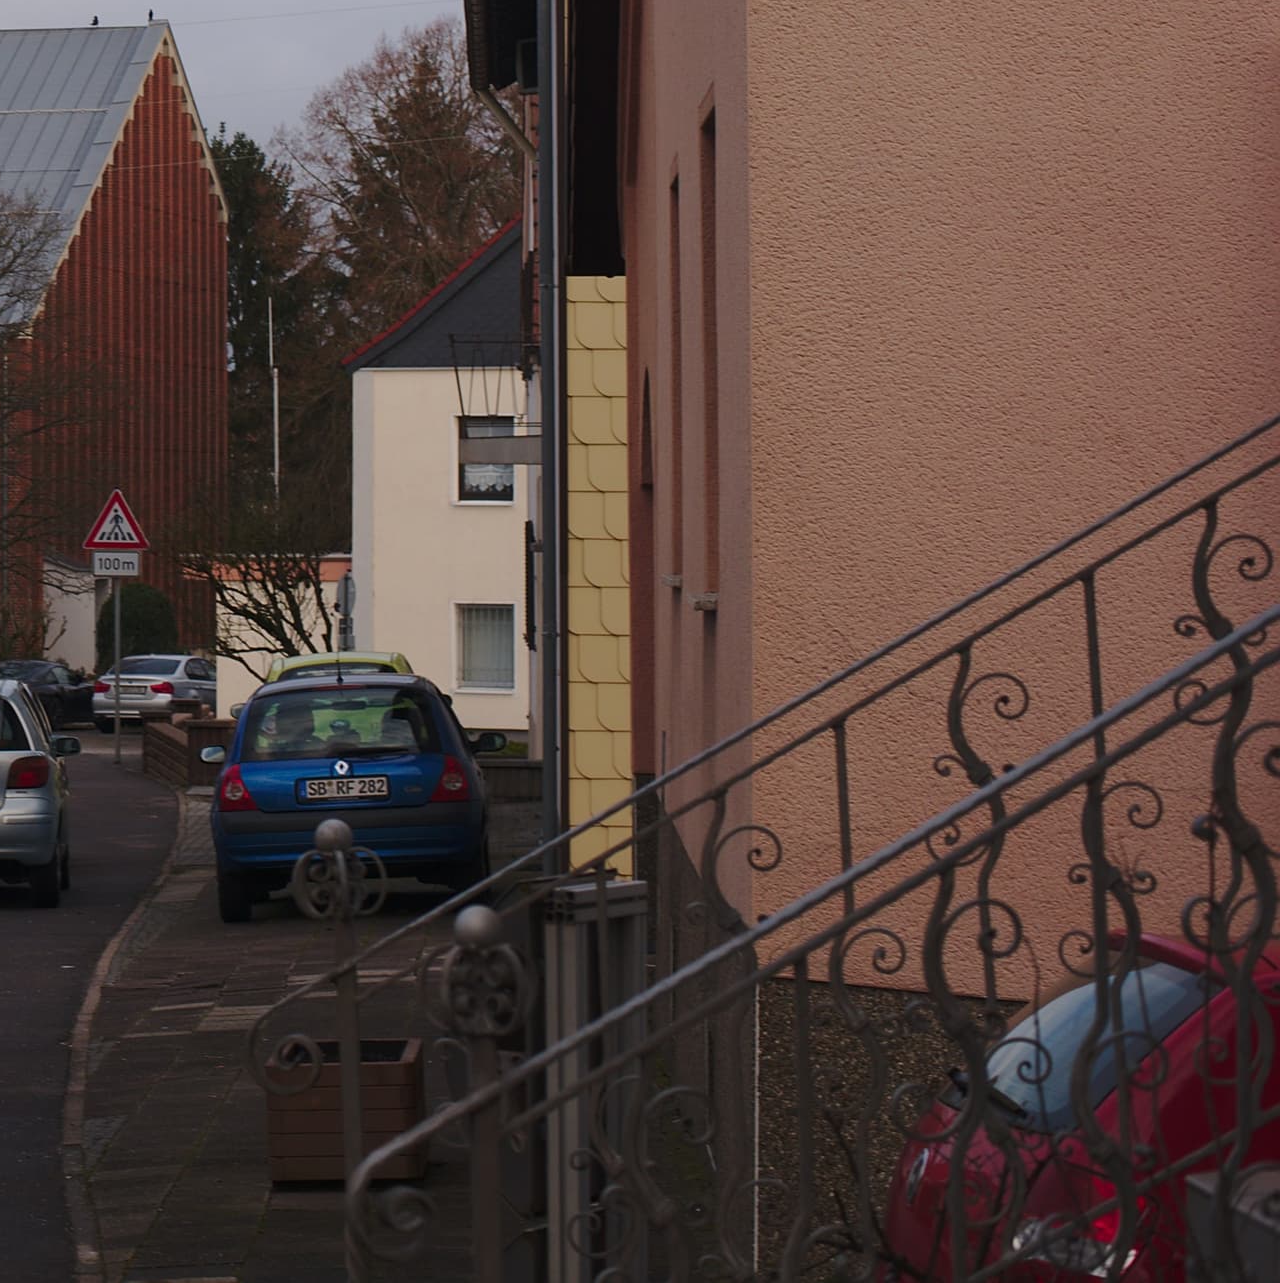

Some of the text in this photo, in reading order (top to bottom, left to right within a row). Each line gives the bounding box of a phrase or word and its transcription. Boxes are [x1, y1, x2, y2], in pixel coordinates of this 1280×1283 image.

[308, 779, 385, 796] SB RF 282
